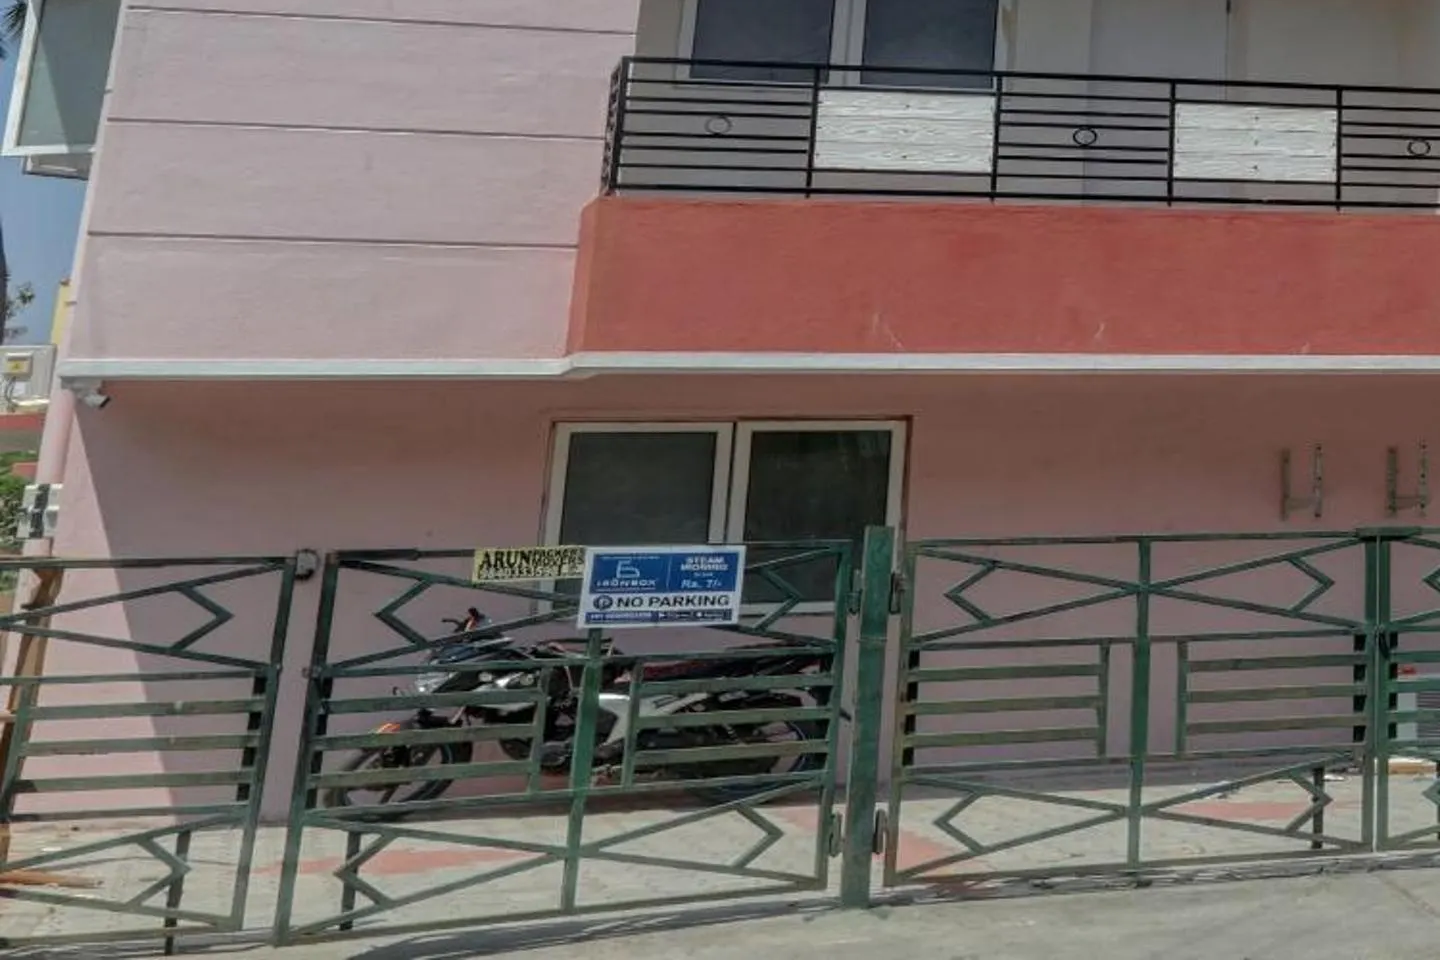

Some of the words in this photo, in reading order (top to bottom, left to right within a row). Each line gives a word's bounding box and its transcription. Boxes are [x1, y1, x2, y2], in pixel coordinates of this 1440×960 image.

[480, 550, 533, 568] ARUN
[616, 596, 643, 607] NO
[648, 595, 730, 608] PARKING
